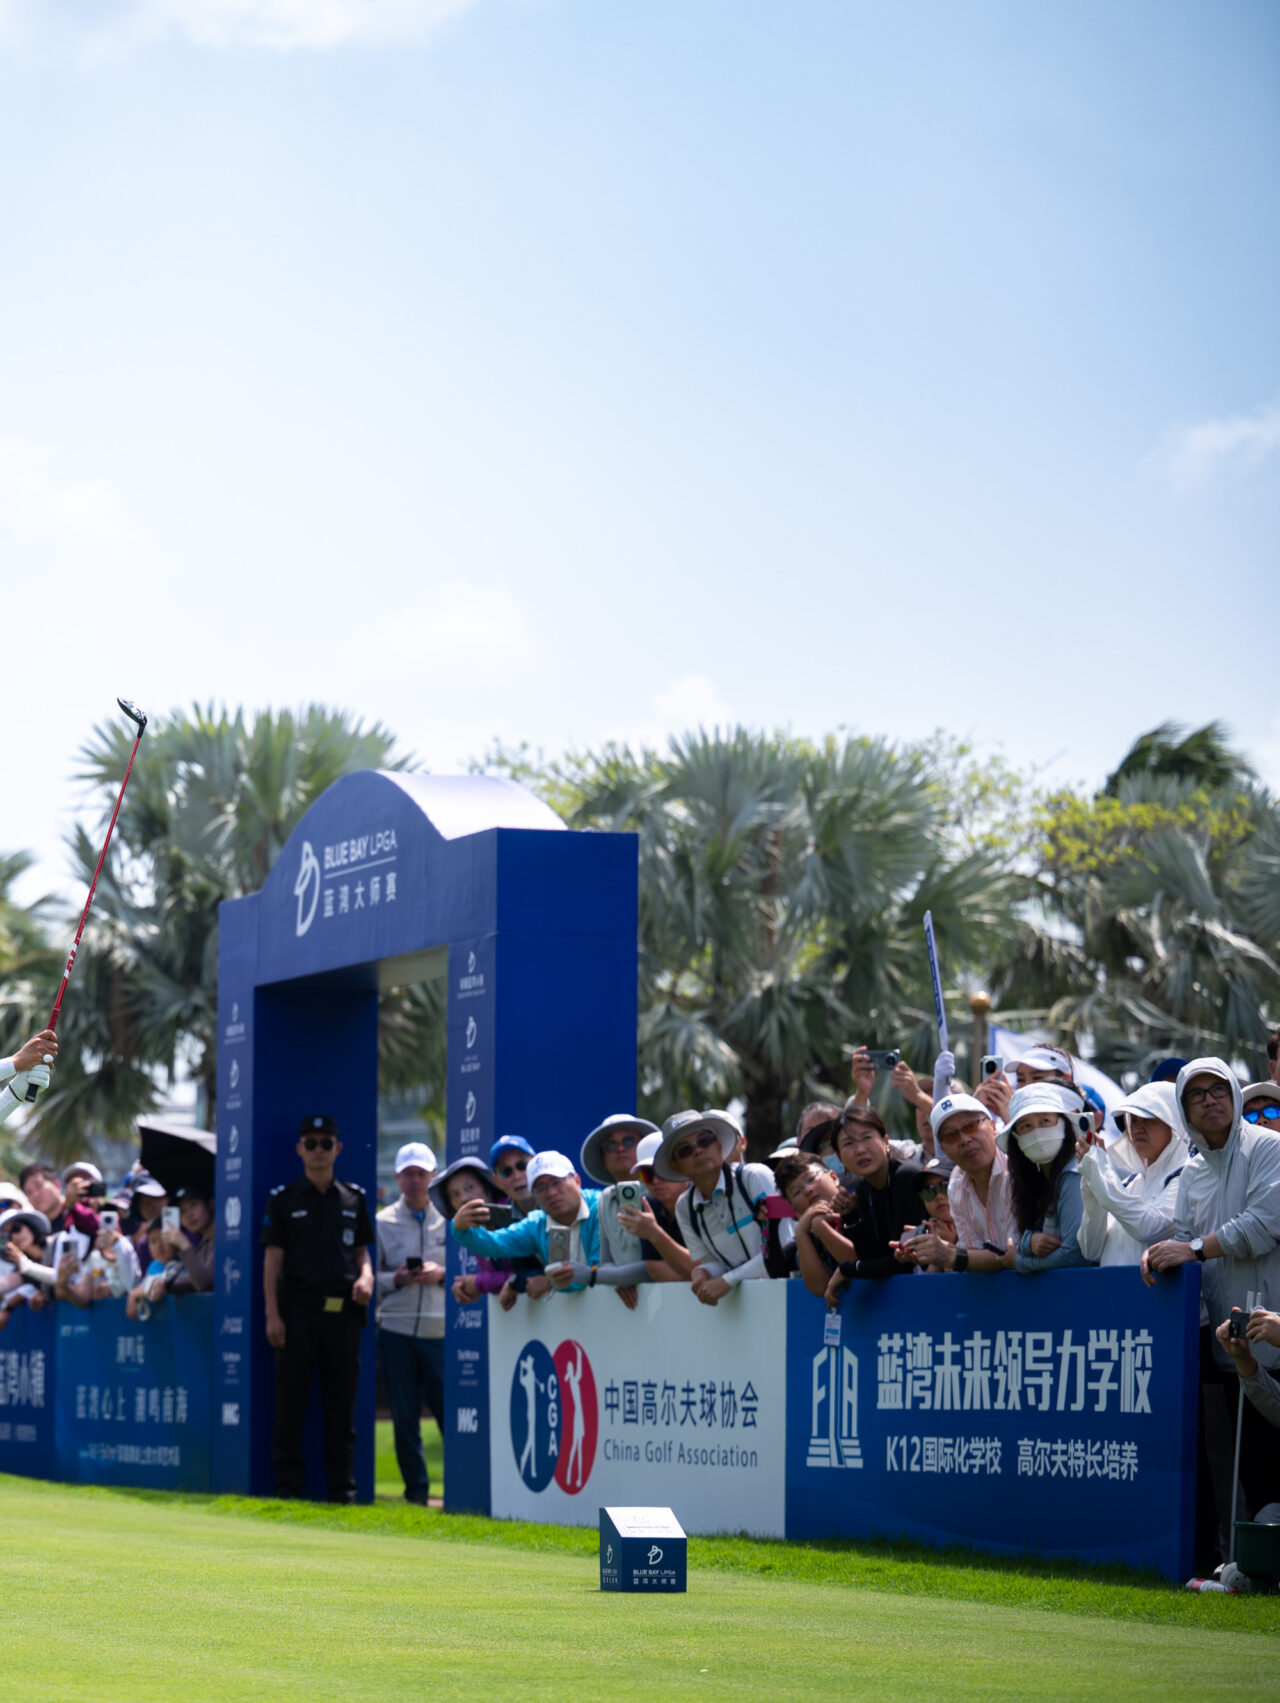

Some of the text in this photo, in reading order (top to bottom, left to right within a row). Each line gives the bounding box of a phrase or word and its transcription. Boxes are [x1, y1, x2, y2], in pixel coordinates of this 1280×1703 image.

[324, 829, 398, 870] BLUE BAY LPGA
[877, 1328, 1153, 1414] 蓝湾未来领导力学校
[547, 1374, 558, 1457] CGA
[604, 1379, 759, 1429] 中国高尔夫球协会
[603, 1438, 758, 1468] China Golf Association
[886, 1435, 1138, 1481] K12国际化学校 高尔夫特长培养
